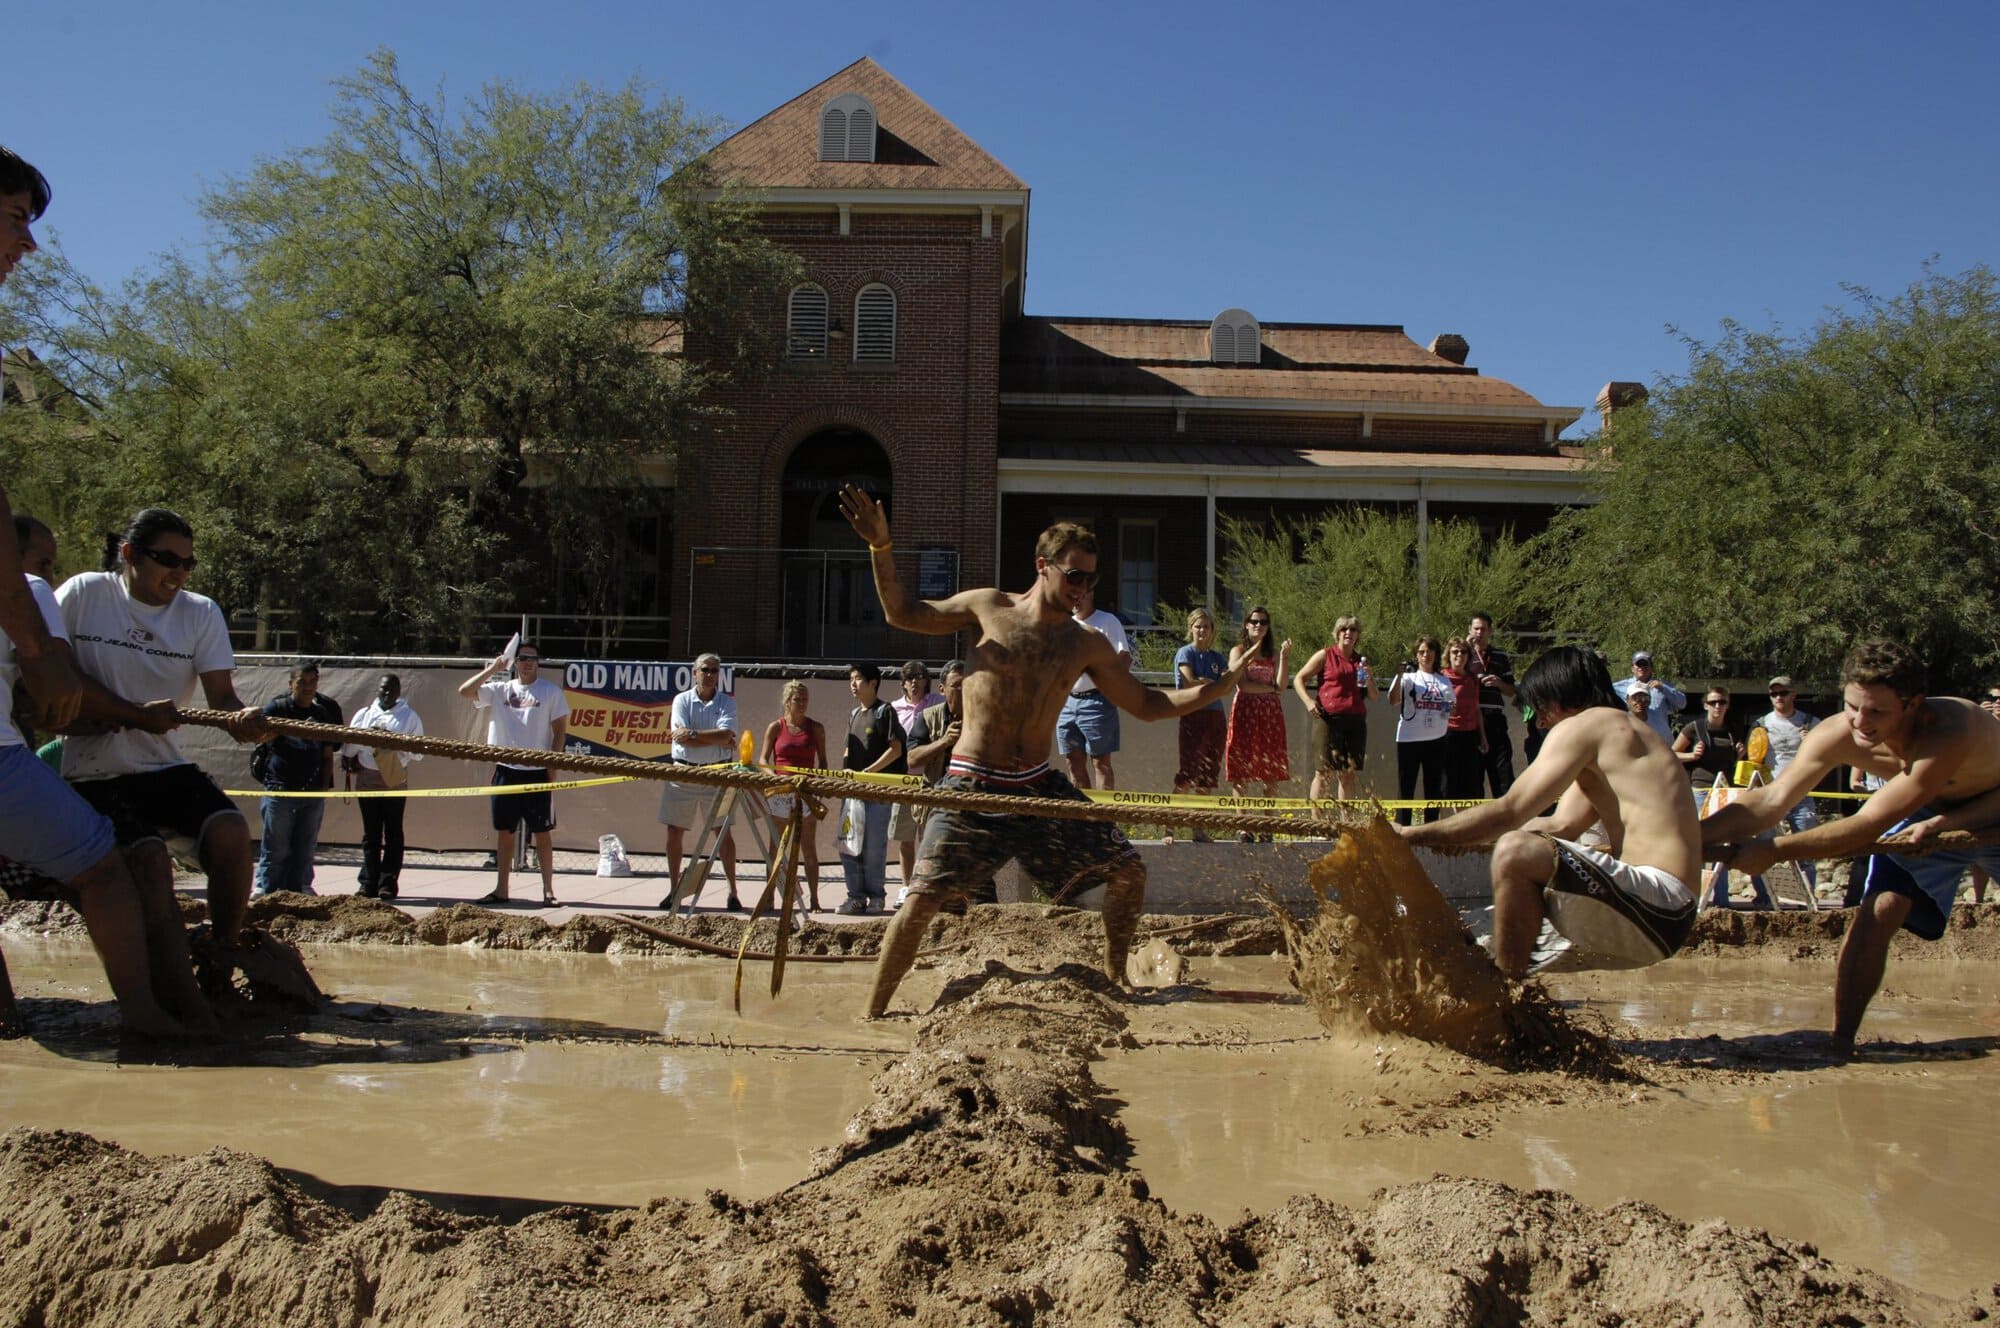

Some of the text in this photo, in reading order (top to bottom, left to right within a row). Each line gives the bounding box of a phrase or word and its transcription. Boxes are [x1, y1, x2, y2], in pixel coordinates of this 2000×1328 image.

[145, 648, 194, 661] COMPAN
[566, 663, 733, 693] OLD MAIN ON
[570, 708, 607, 727] USE
[610, 710, 664, 729] WEST
[605, 729, 673, 746] By Founta
[1113, 792, 1171, 806] CAUTION
[1218, 797, 1276, 809] CAUTION
